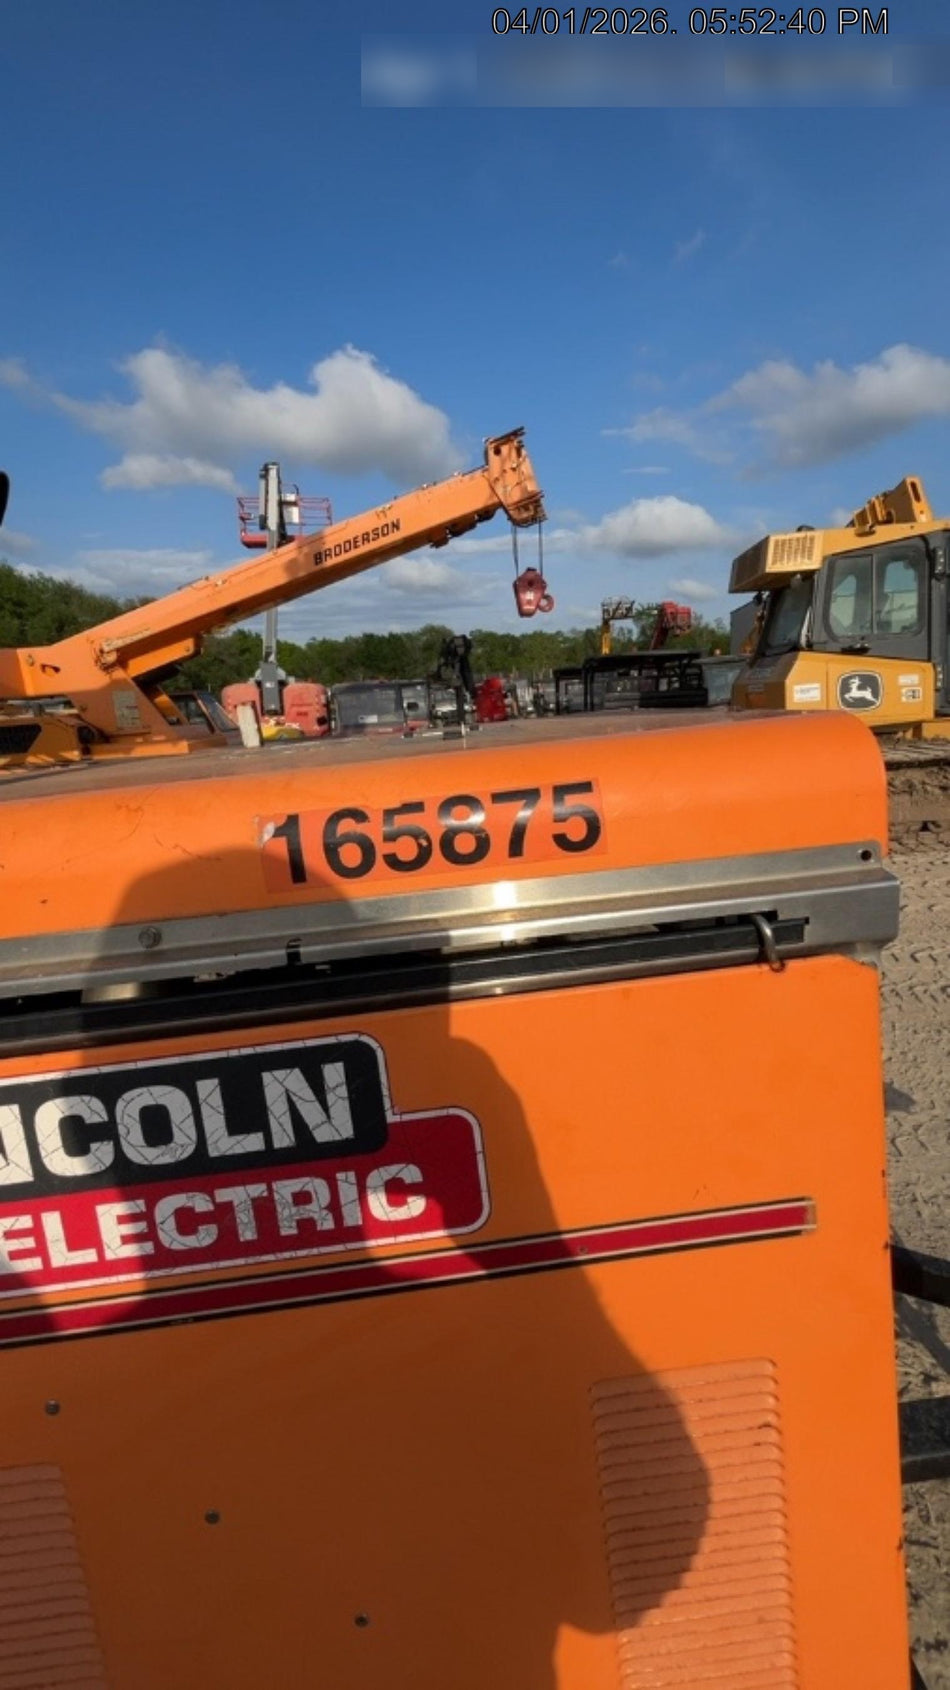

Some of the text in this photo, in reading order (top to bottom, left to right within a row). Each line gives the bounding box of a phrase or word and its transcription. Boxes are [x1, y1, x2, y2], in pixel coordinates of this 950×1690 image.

[313, 518, 401, 566] BRODERSON
[272, 781, 601, 884] 165875
[0, 1163, 426, 1275] ELECTRIC
